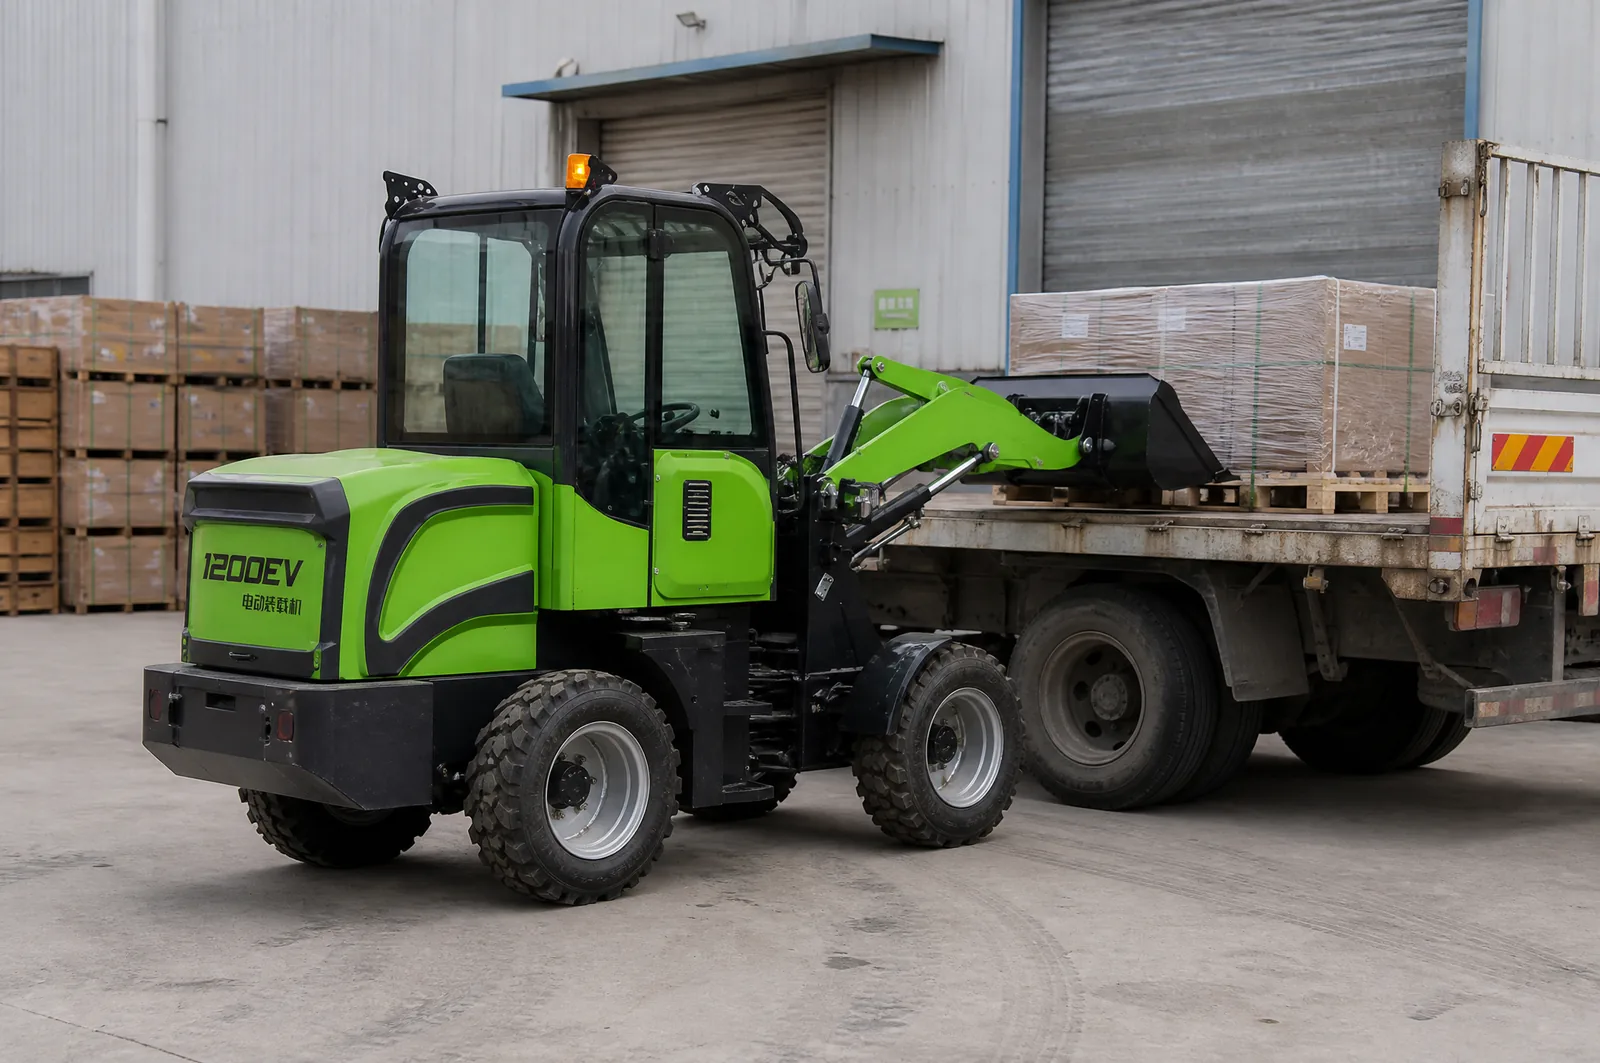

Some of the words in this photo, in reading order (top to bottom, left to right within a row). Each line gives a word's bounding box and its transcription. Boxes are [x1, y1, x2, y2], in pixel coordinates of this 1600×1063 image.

[203, 552, 304, 587] 1200EV
[242, 593, 302, 616] 电动装载机
